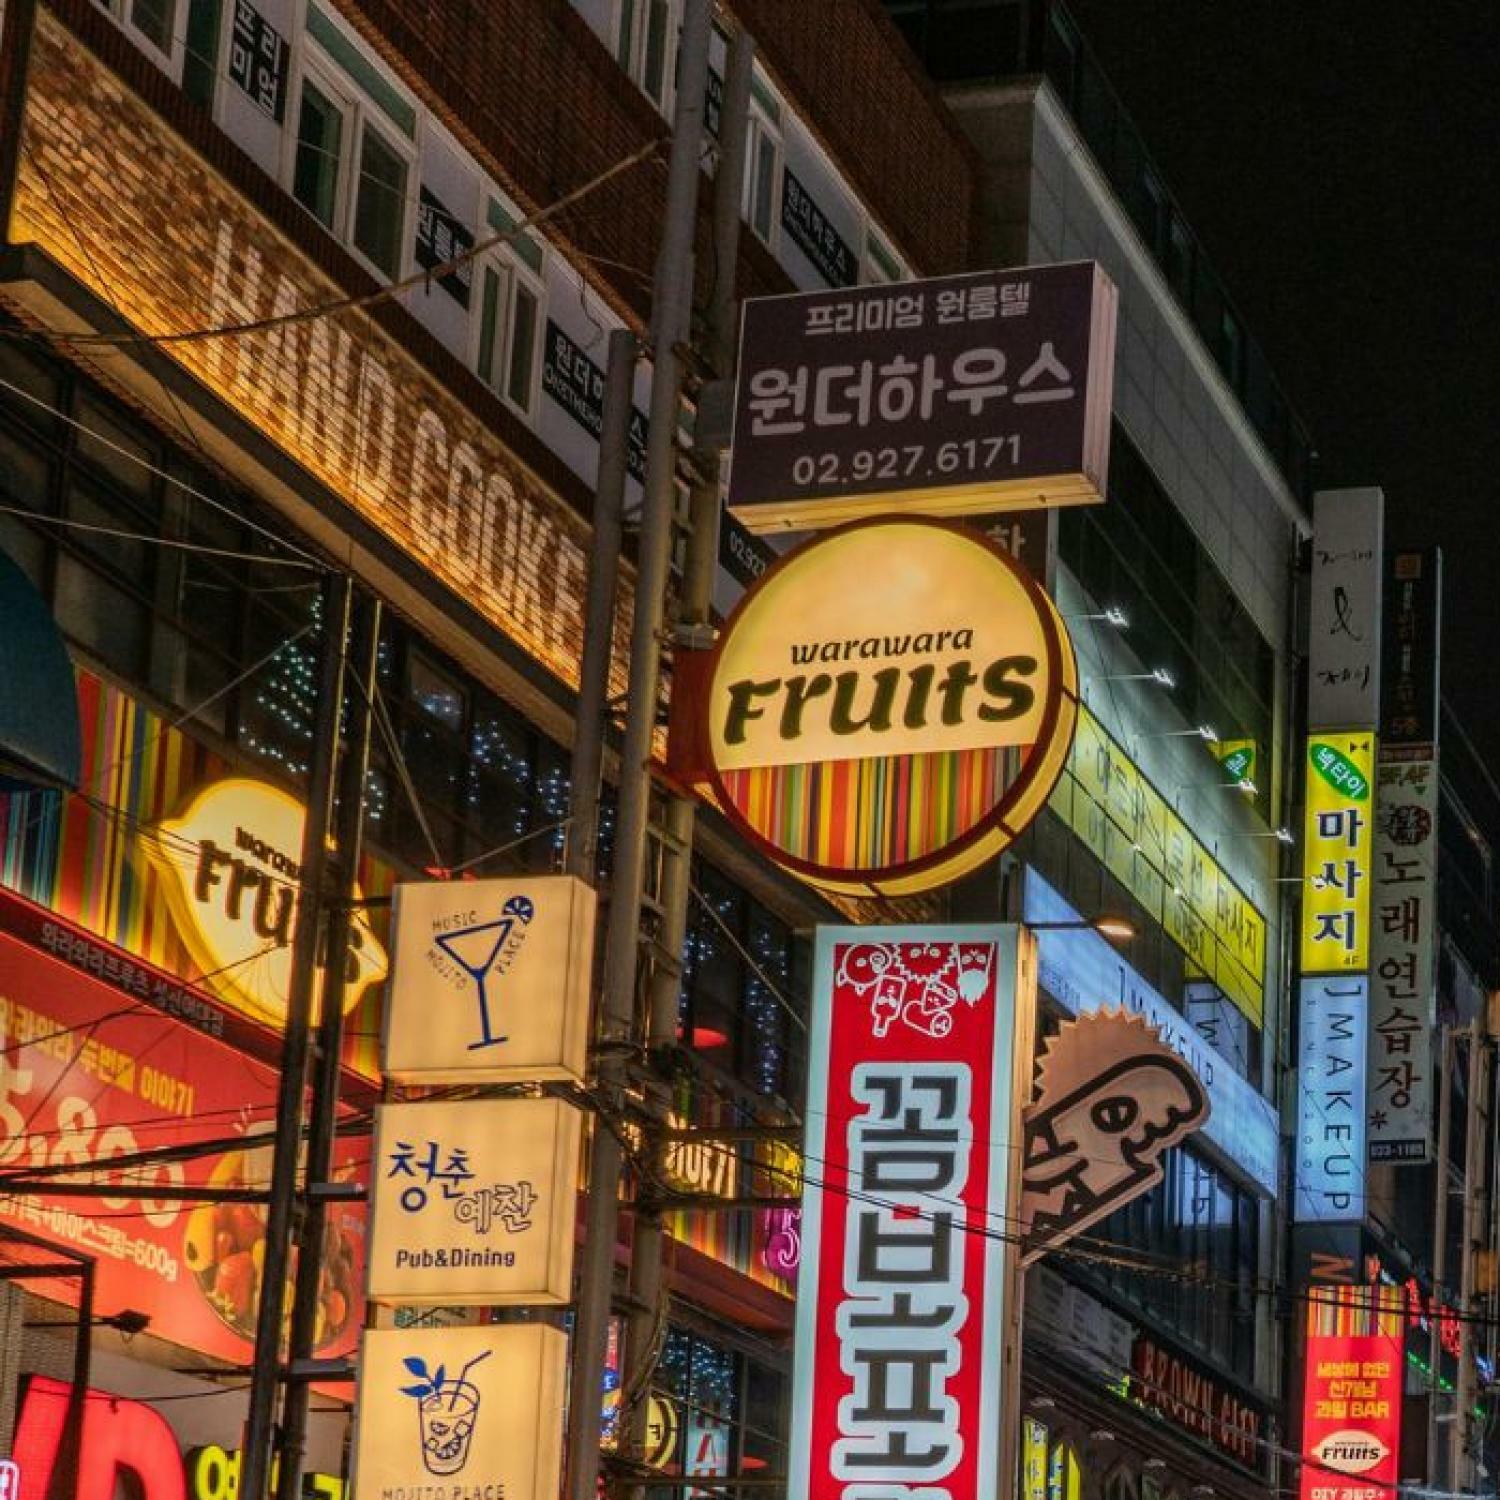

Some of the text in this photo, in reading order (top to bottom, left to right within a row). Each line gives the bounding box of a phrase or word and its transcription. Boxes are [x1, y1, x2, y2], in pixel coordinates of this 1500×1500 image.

[805, 282, 1031, 336] 프리미엄 원룸텔
[749, 341, 1075, 437] 원더하우스
[791, 434, 1022, 486] 02.927.6171
[789, 627, 974, 666] warawara
[723, 655, 1039, 746] Fruits
[1315, 747, 1366, 798] 넥타이
[1313, 808, 1364, 950] 마사지
[1376, 853, 1426, 1110] 노래연습장
[140, 1066, 195, 1118] 이야기
[388, 1141, 476, 1213] 청춘
[454, 1181, 539, 1235] 예찬
[396, 1247, 516, 1269] Pub&Dining
[1351, 1400, 1390, 1418] BAR
